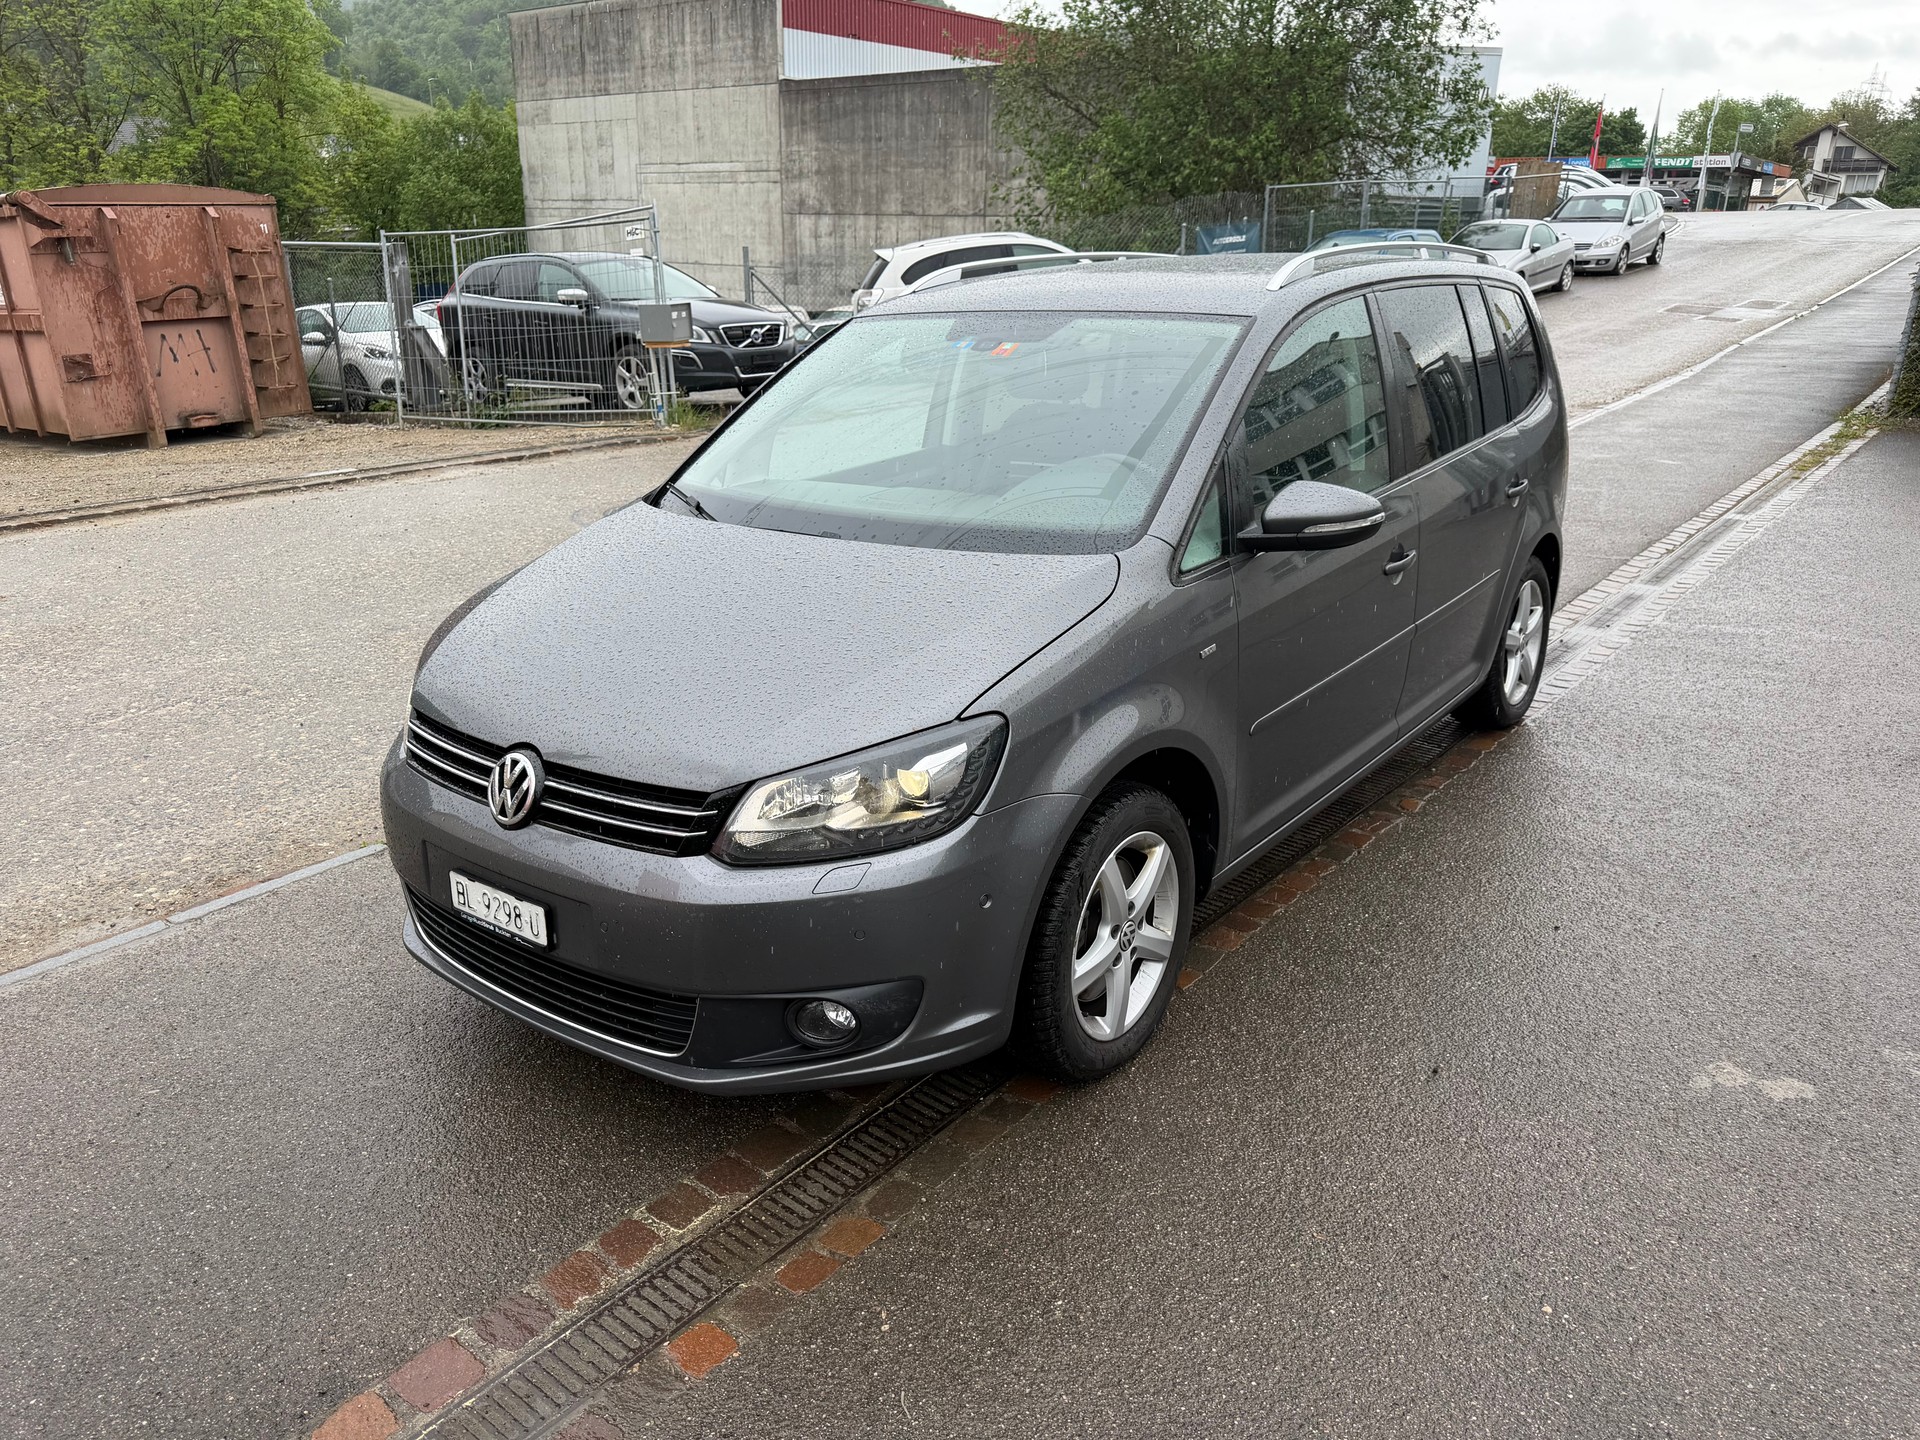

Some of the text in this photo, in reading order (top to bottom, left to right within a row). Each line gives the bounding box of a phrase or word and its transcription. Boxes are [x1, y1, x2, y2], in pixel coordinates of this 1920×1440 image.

[1655, 157, 1693, 167] FENDT
[260, 223, 269, 234] 11
[456, 881, 540, 938] BL 9298 U
